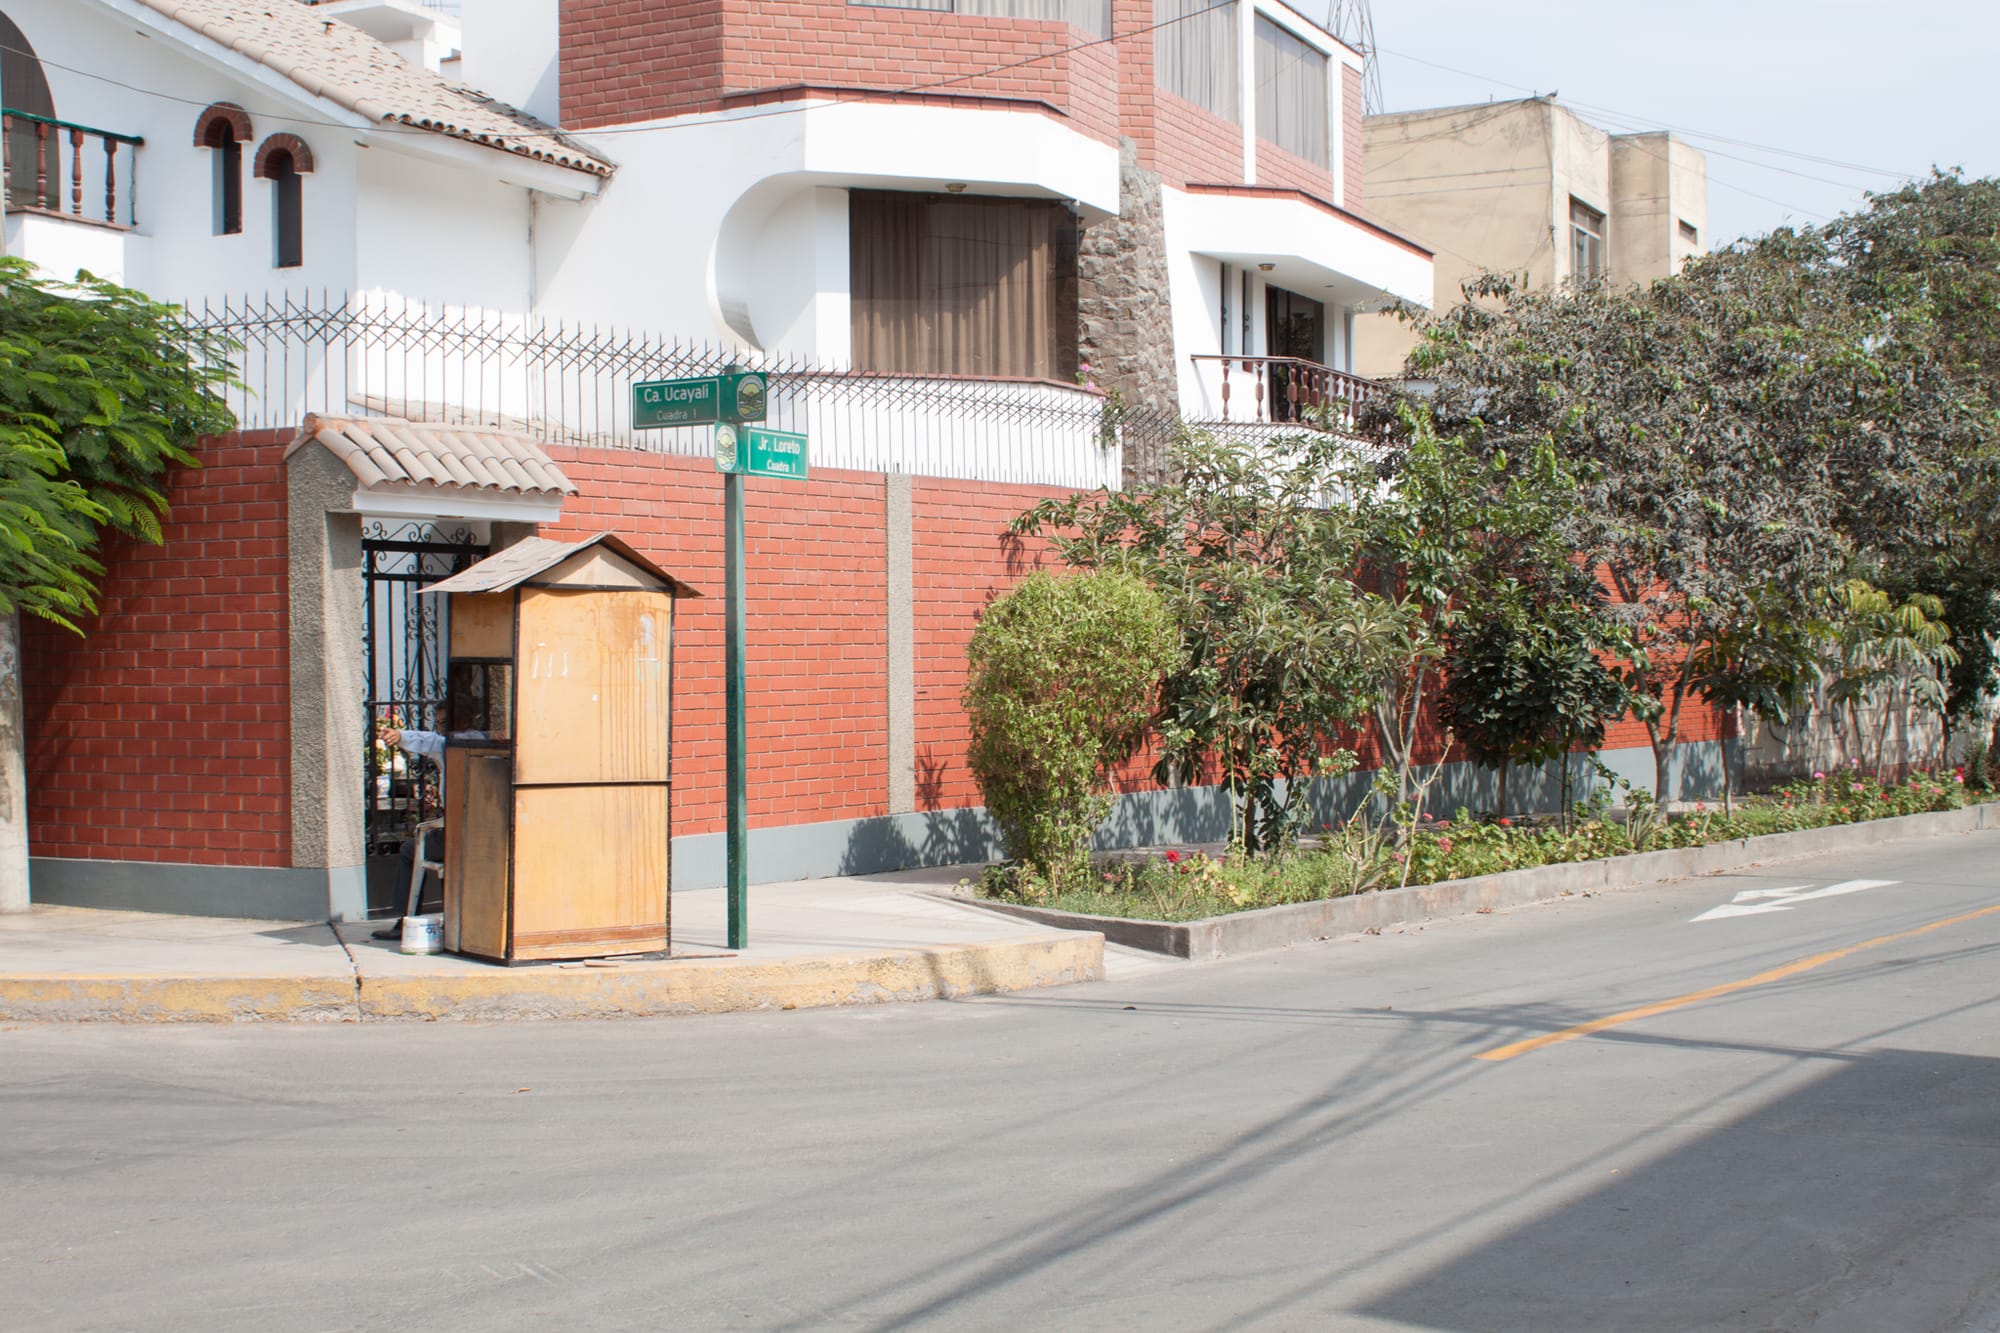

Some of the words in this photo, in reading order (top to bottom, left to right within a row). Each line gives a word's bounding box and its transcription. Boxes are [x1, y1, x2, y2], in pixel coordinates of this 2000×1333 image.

[644, 388, 662, 403] Ca.
[664, 384, 709, 403] Ucayali
[656, 410, 688, 421] Cuadra
[758, 436, 771, 451] Jr.
[773, 437, 800, 455] Loreto
[767, 459, 790, 472] Cuadra
